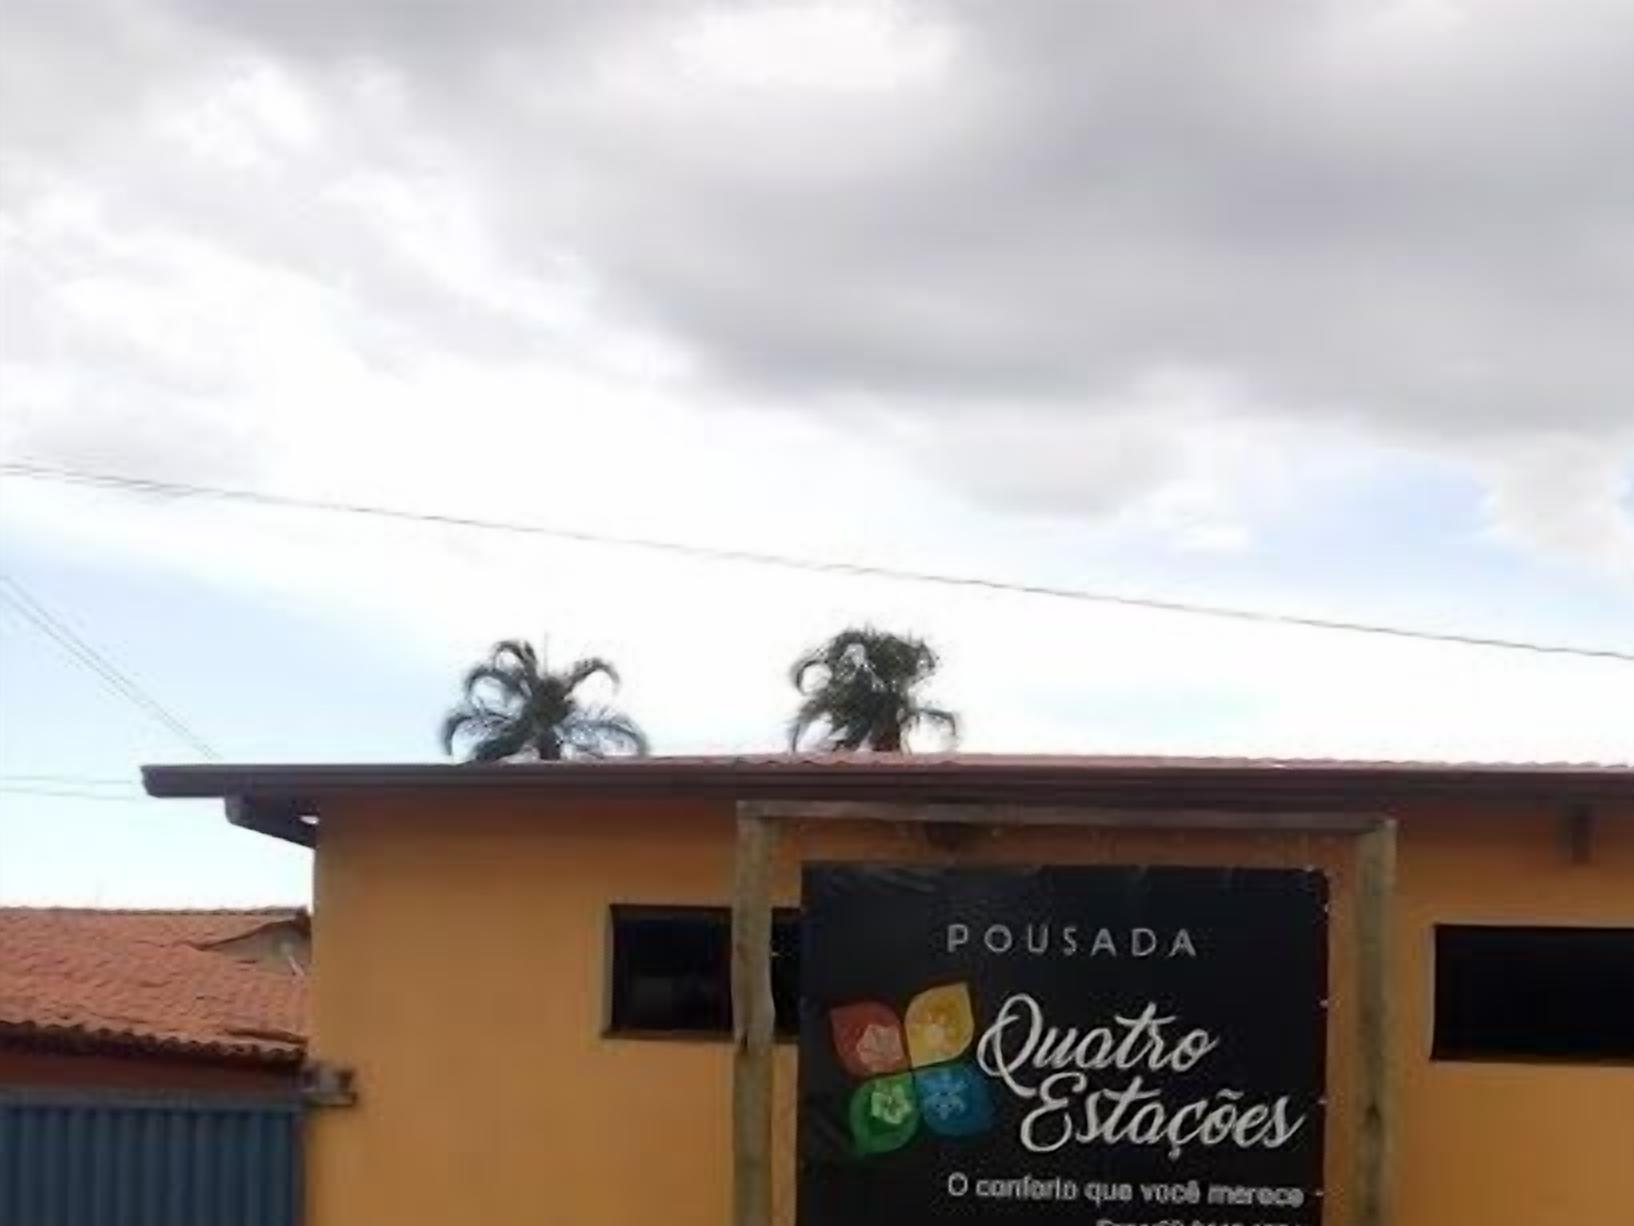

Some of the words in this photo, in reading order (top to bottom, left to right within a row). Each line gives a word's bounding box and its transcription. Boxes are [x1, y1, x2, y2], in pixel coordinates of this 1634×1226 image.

[947, 922, 1197, 958] POUSADA
[976, 993, 1220, 1098] Quatro
[1020, 1072, 1307, 1160] Estações
[948, 1172, 969, 1196] O
[976, 1174, 1078, 1200] conforto
[1084, 1182, 1134, 1208] que
[1140, 1179, 1201, 1204] você
[1207, 1184, 1305, 1208] merece
